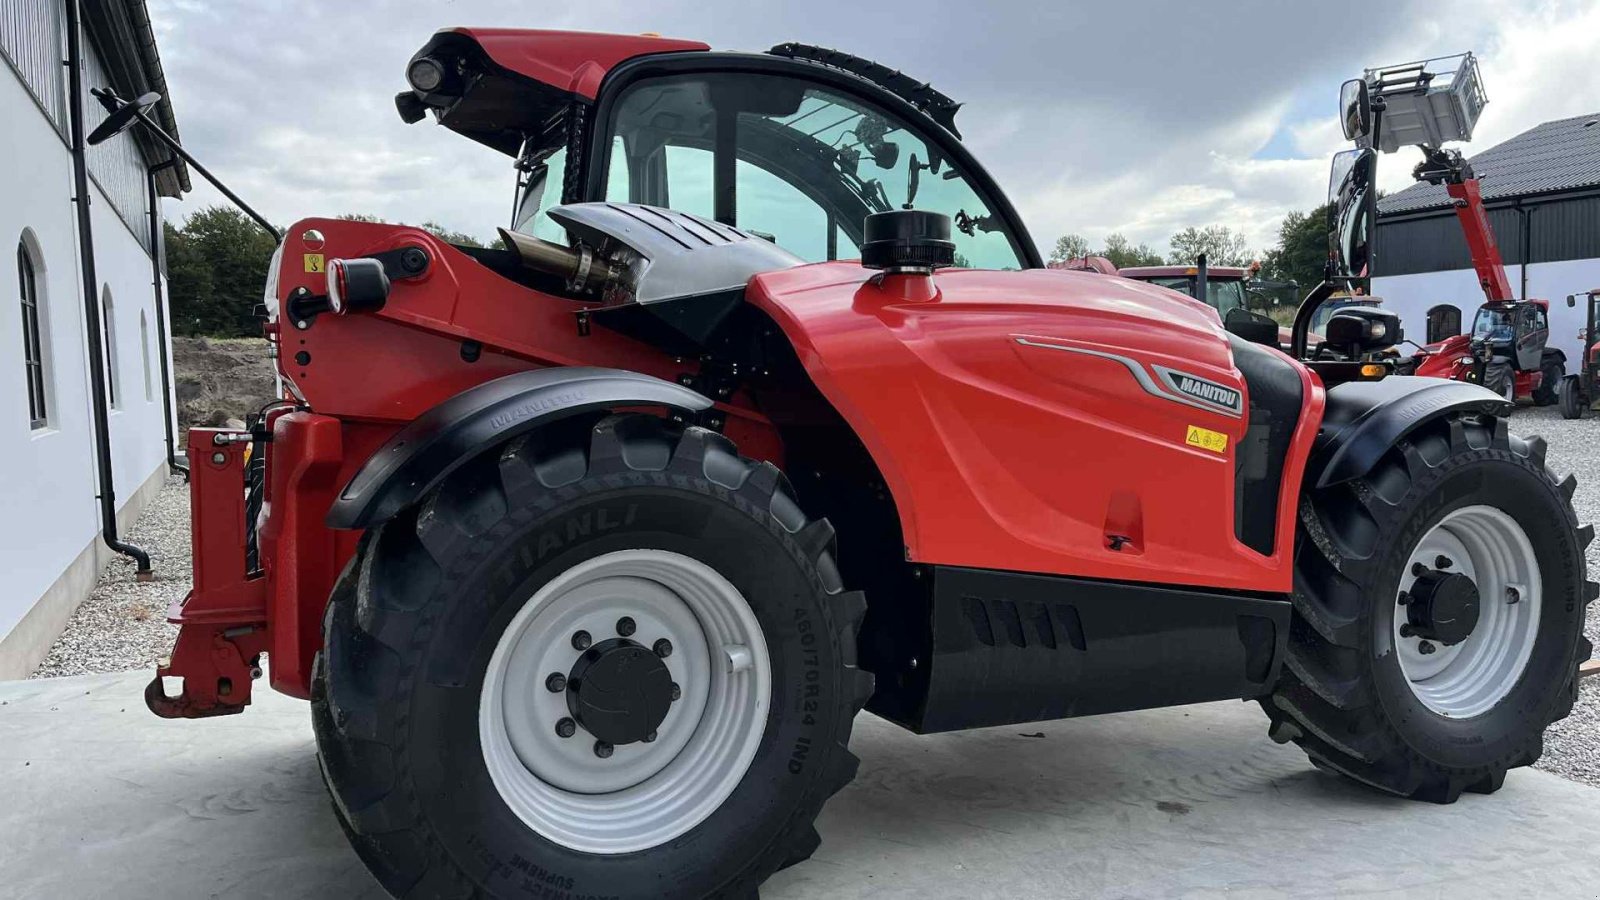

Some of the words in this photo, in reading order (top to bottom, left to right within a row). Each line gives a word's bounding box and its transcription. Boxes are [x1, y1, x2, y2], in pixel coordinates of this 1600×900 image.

[490, 390, 588, 430] MANITOU
[1180, 377, 1236, 405] MANITOU
[794, 607, 820, 727] 460/70R24
[788, 736, 811, 775] IND
[509, 853, 576, 890] SUPREME
